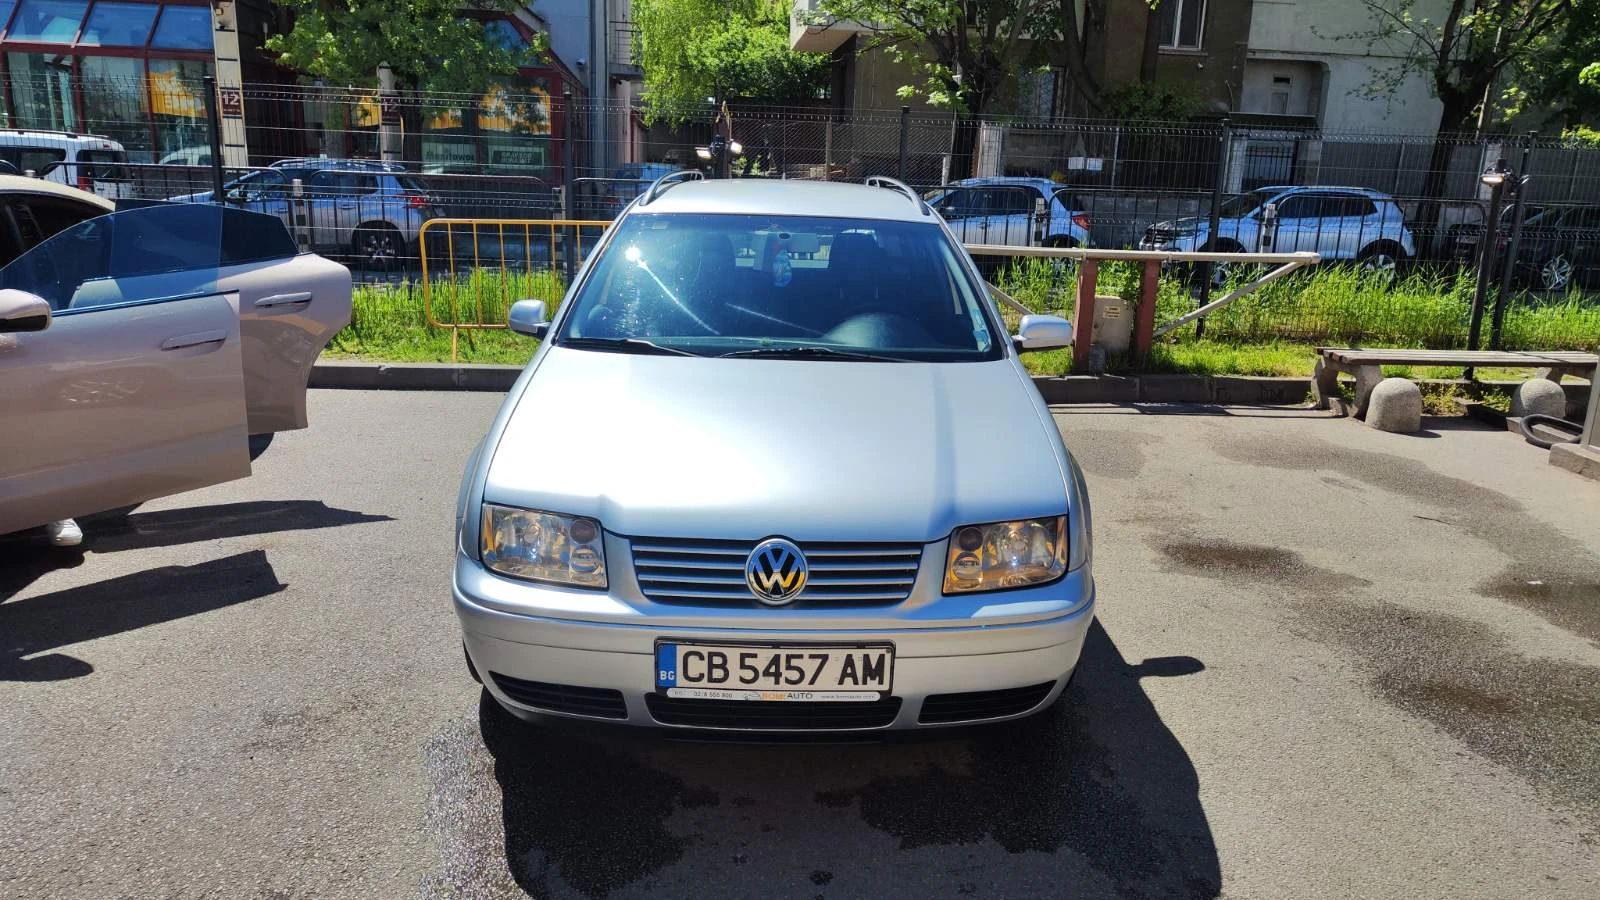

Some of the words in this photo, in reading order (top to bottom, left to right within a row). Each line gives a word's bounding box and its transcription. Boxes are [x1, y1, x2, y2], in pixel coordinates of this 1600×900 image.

[748, 542, 806, 602] VW
[659, 670, 675, 681] BG
[682, 650, 730, 683] CB
[738, 652, 829, 686] 5457
[838, 653, 885, 686] AM
[787, 692, 814, 700] AUTO
